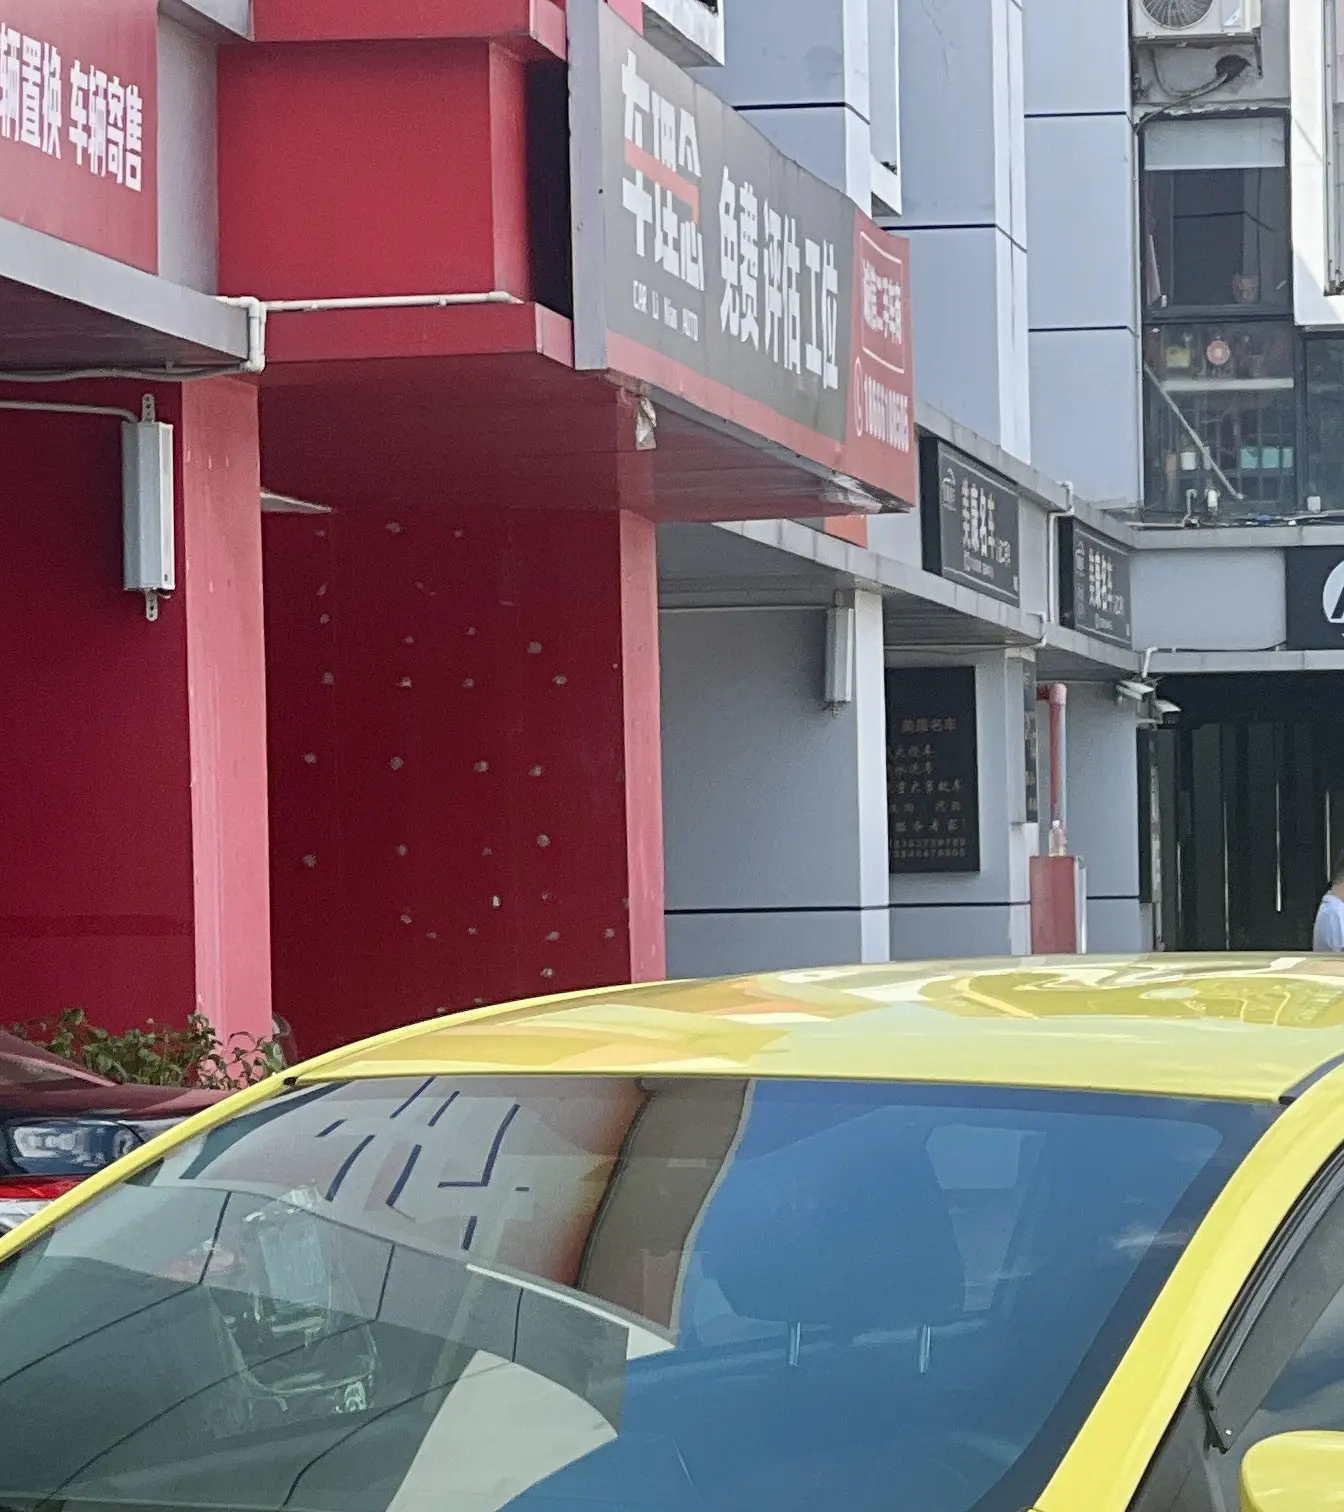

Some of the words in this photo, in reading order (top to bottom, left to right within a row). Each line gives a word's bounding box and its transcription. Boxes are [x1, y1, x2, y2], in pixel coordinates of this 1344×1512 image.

[69, 59, 143, 192] 车辆寄售
[718, 164, 838, 390] 免费评估工位
